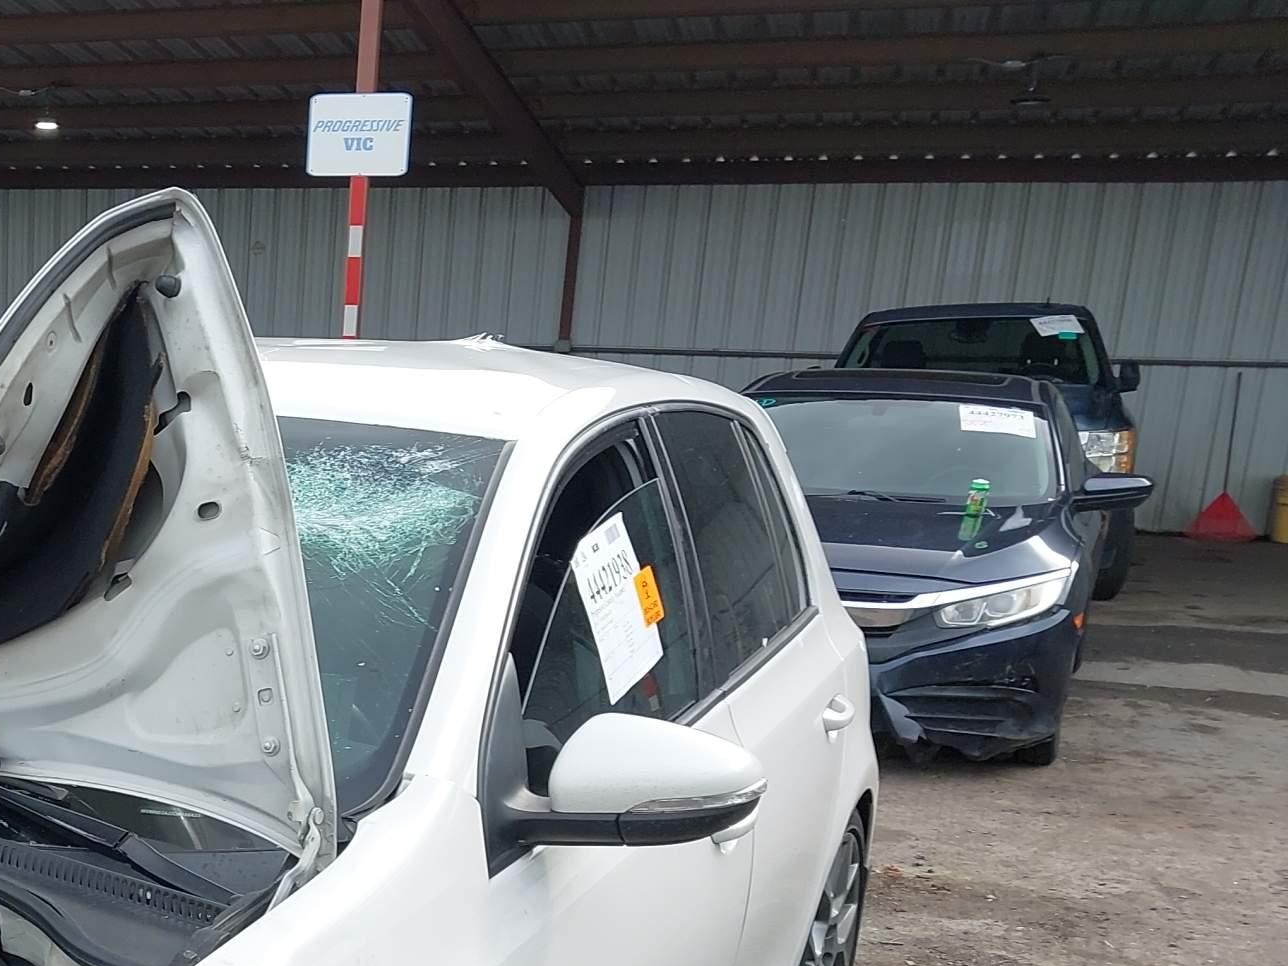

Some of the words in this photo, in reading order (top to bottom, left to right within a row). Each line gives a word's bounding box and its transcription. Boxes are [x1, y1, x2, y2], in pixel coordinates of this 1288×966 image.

[313, 119, 405, 133] PROGRESSIVE
[344, 137, 374, 151] VIC
[587, 549, 632, 604] 44421938
